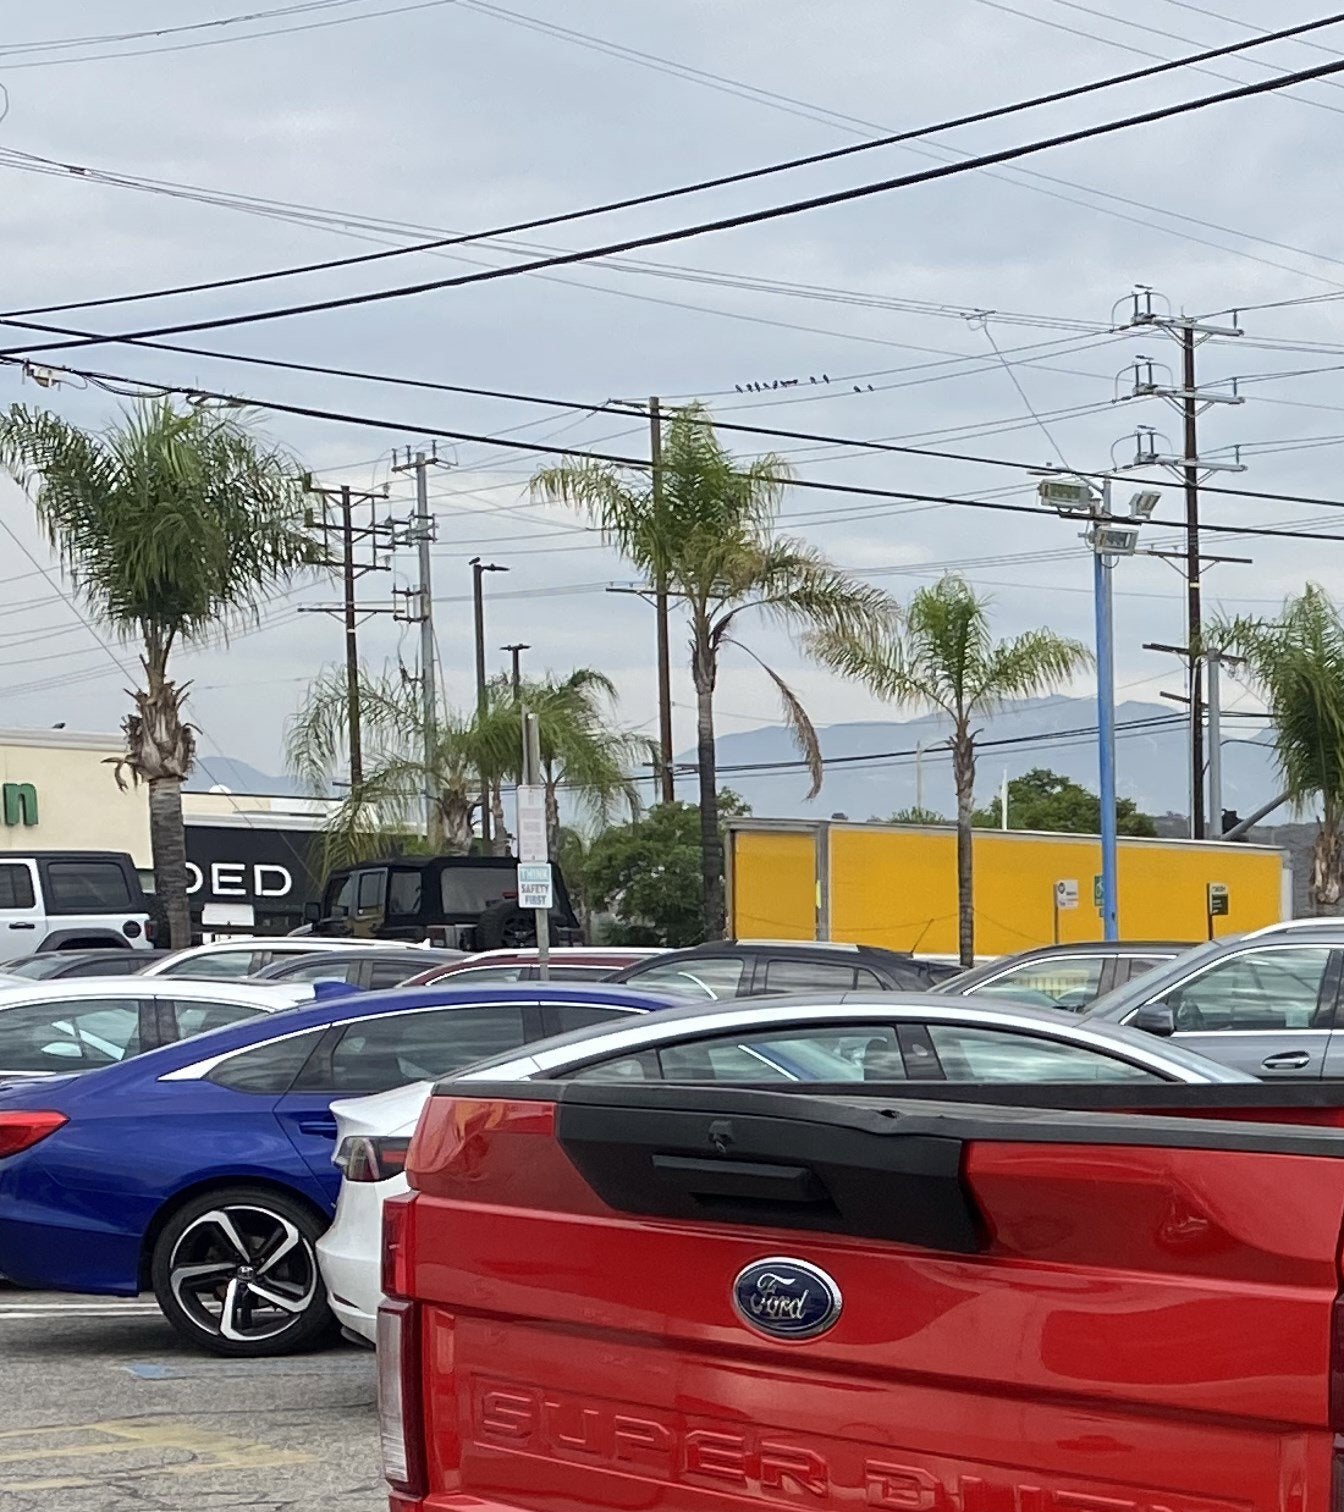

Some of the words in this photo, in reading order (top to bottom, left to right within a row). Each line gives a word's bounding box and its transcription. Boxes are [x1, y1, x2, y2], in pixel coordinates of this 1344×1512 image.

[521, 883, 549, 894] SAFETY
[525, 895, 547, 905] FIRST
[750, 1272, 809, 1320] Ford
[479, 1388, 830, 1498] SUPER
